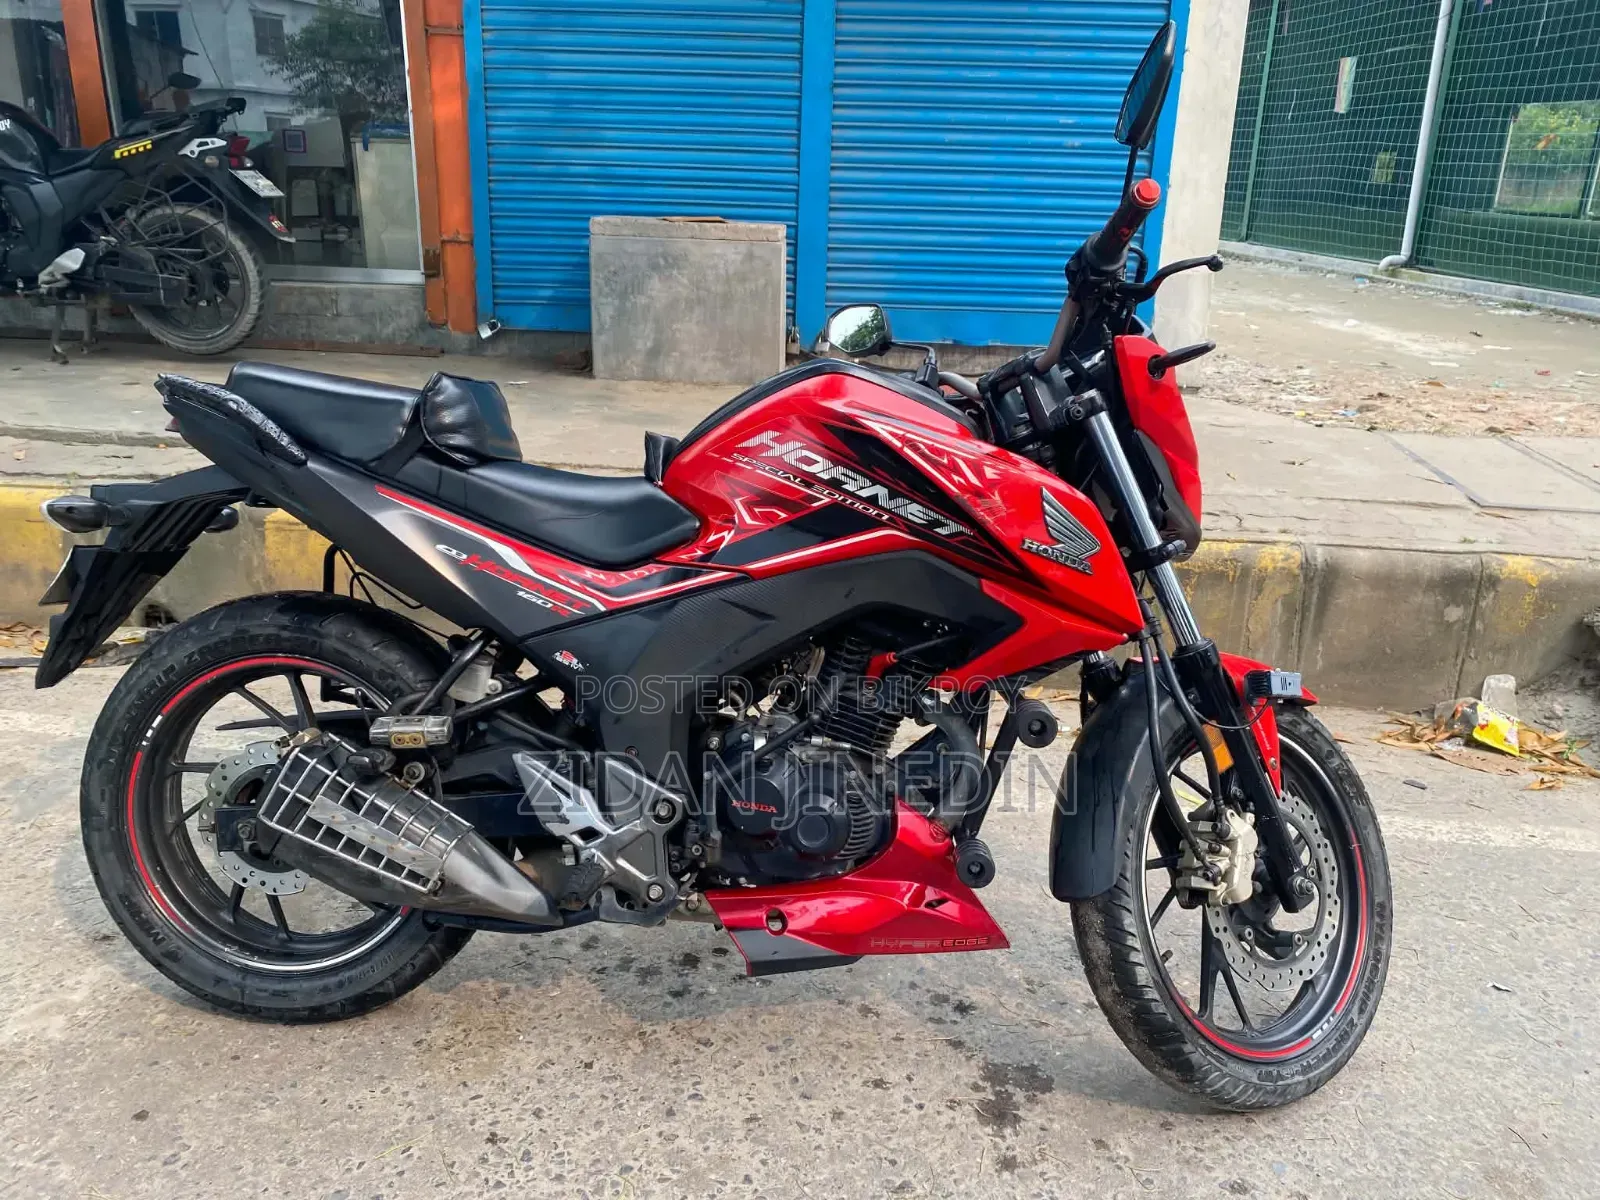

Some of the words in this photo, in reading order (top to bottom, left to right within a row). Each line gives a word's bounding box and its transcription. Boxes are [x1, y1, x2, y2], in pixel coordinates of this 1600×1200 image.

[731, 453, 806, 487] SPECIAL
[812, 484, 891, 521] EDITION
[734, 430, 974, 536] HORNET
[1022, 537, 1094, 575] HONDA
[458, 554, 592, 611] HORNET
[516, 590, 571, 618] 160R
[732, 800, 777, 813] HONDA
[871, 937, 941, 949] HYPER
[942, 937, 988, 947] EDGE
